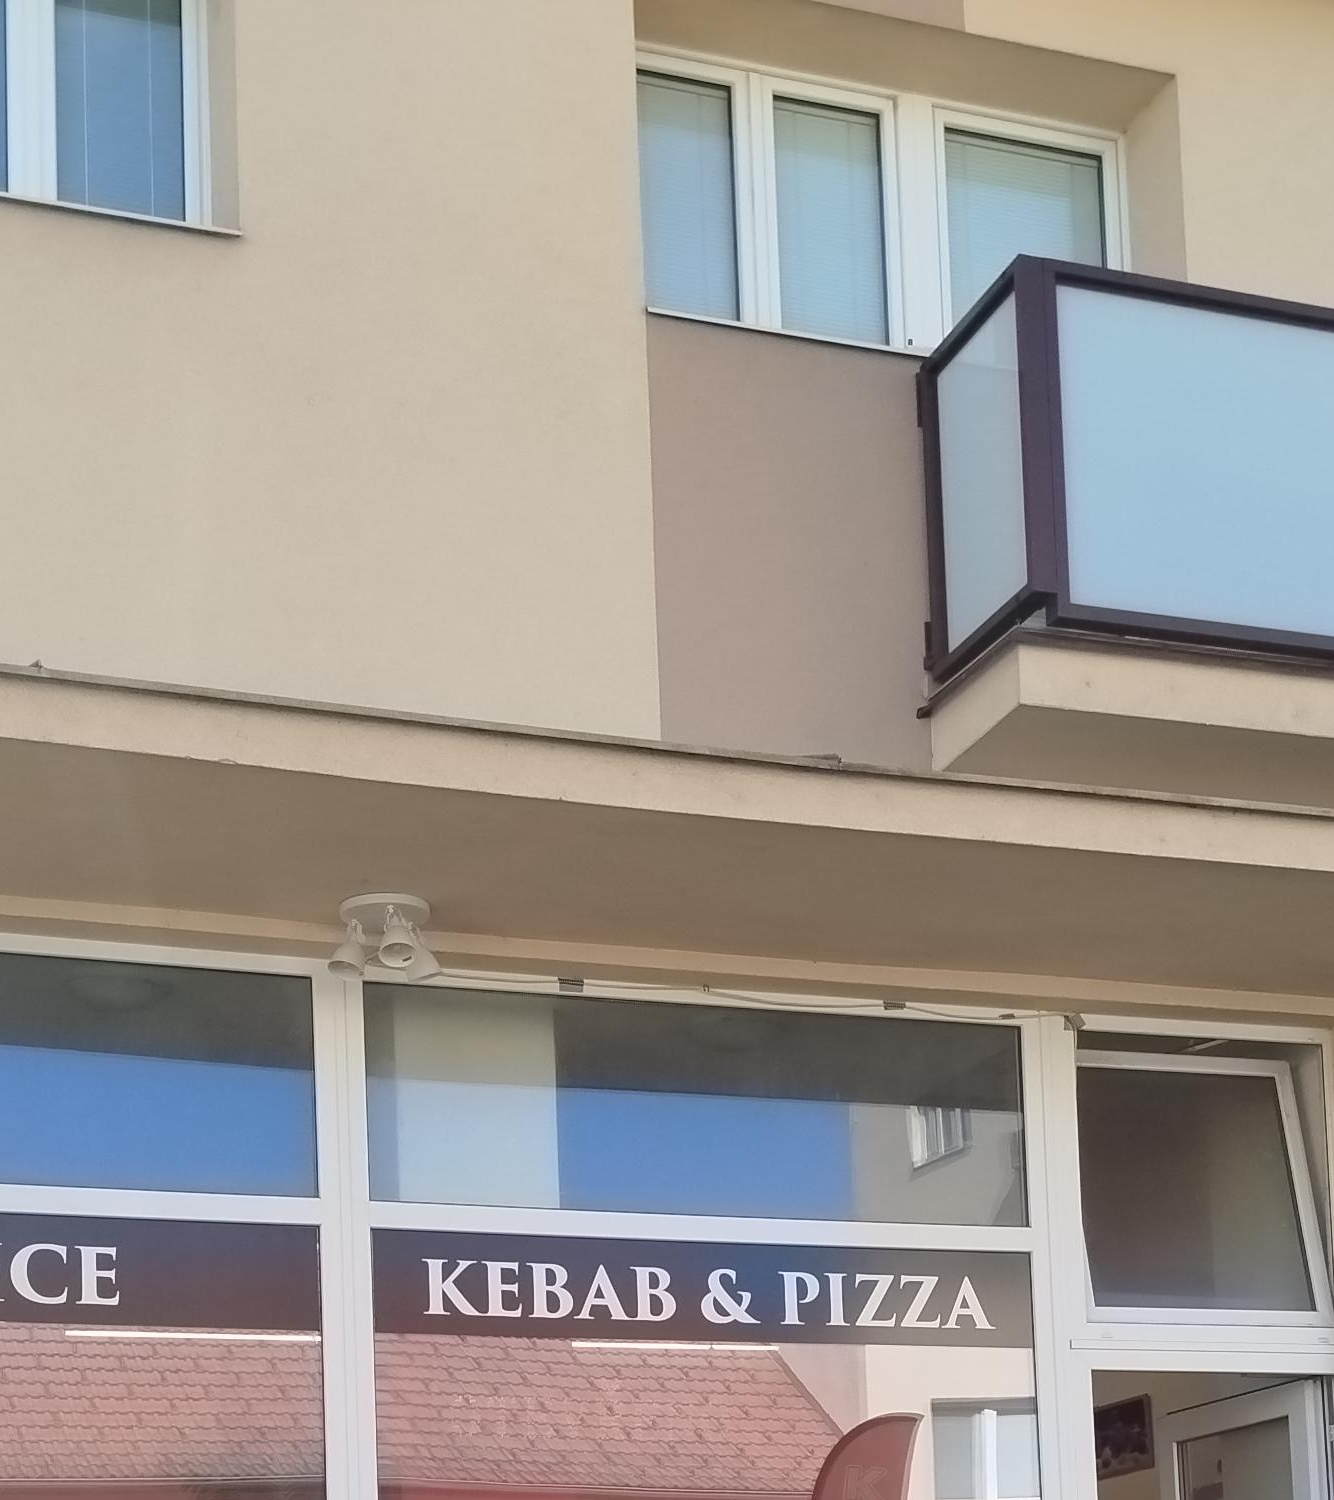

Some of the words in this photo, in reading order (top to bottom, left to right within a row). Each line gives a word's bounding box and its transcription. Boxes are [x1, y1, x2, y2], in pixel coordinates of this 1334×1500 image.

[422, 1258, 678, 1322] KEBAB
[699, 1268, 762, 1325] &
[779, 1270, 996, 1331] PIZZA
